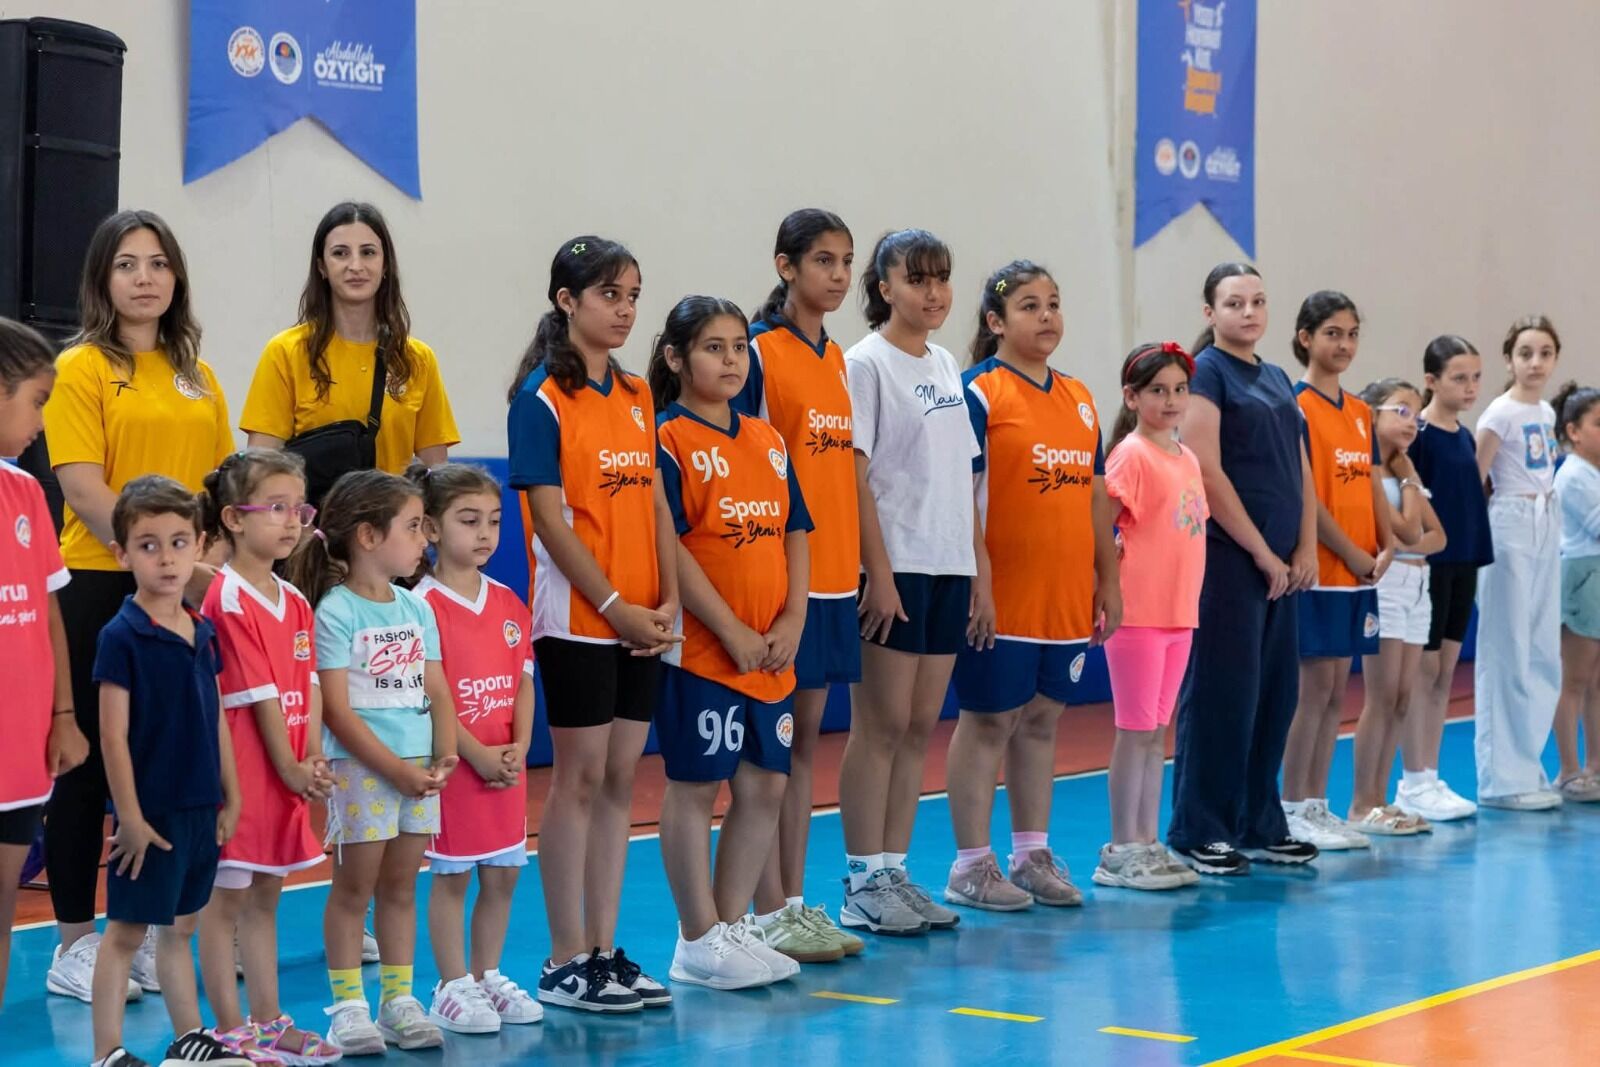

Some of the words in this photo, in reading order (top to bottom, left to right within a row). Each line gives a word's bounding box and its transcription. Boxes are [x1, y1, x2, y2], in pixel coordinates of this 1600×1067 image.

[691, 446, 730, 483] 96
[719, 497, 780, 523] Sporu
[747, 520, 776, 544] Yeni
[394, 679, 403, 689] a
[458, 675, 513, 700] Sporu
[697, 705, 744, 756] 96
